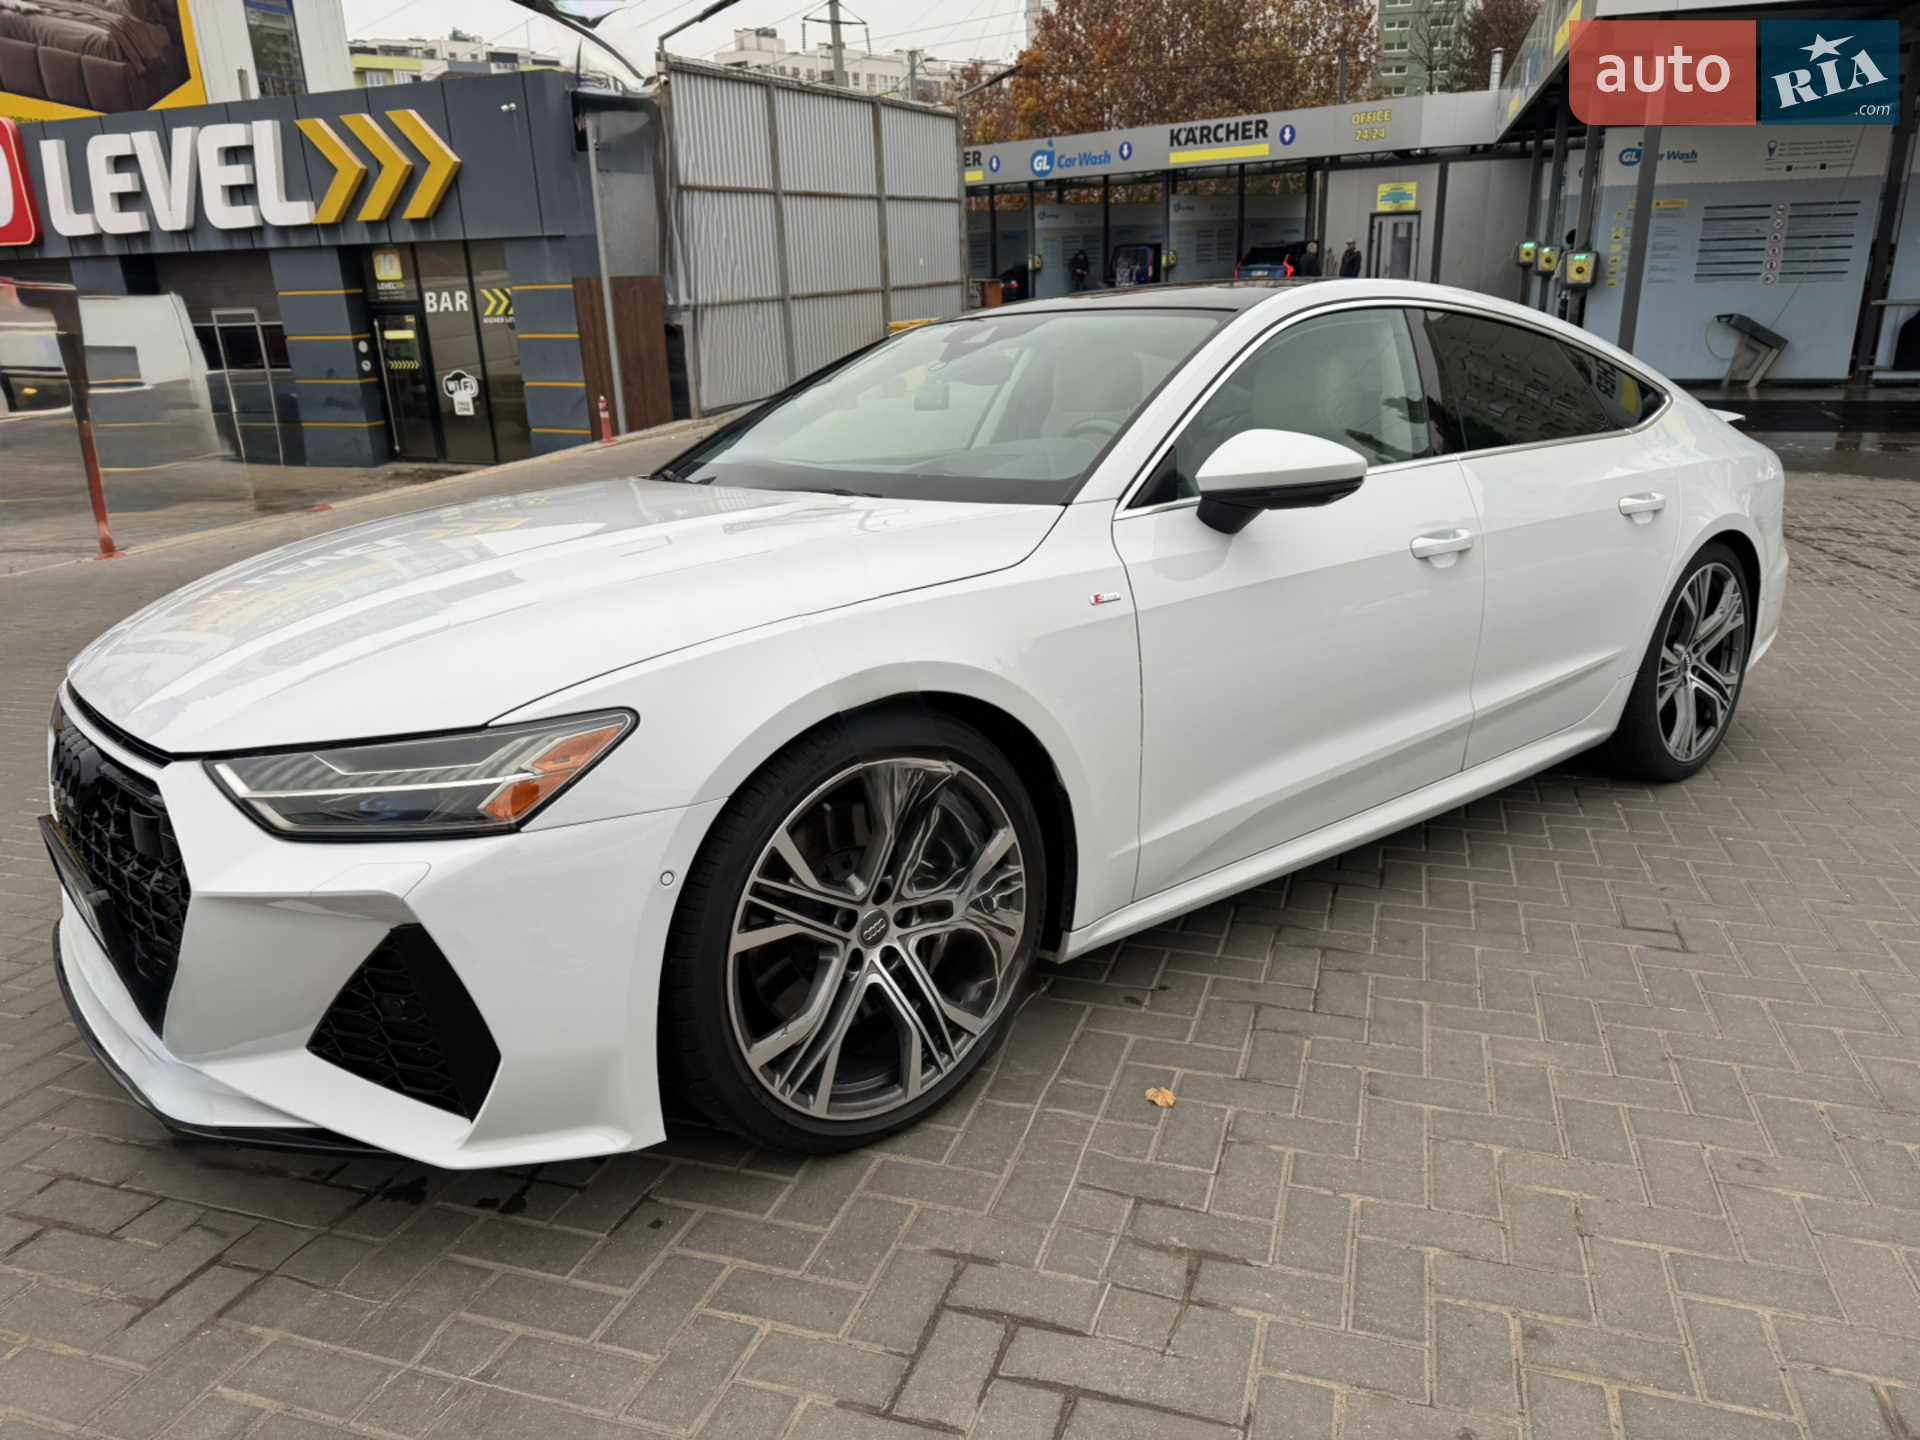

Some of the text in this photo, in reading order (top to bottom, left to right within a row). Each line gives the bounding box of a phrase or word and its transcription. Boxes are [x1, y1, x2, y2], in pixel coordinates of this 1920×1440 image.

[1351, 109, 1392, 125] OFFICE
[1169, 119, 1269, 147] KÄRCHER
[1354, 127, 1388, 142] 24/24
[1033, 150, 1111, 171] GL Car Wash
[1622, 151, 1639, 163] GL
[1666, 149, 1698, 161] Wash
[40, 120, 316, 237] LEVEL
[375, 254, 398, 276] 10
[424, 290, 469, 313] BAR
